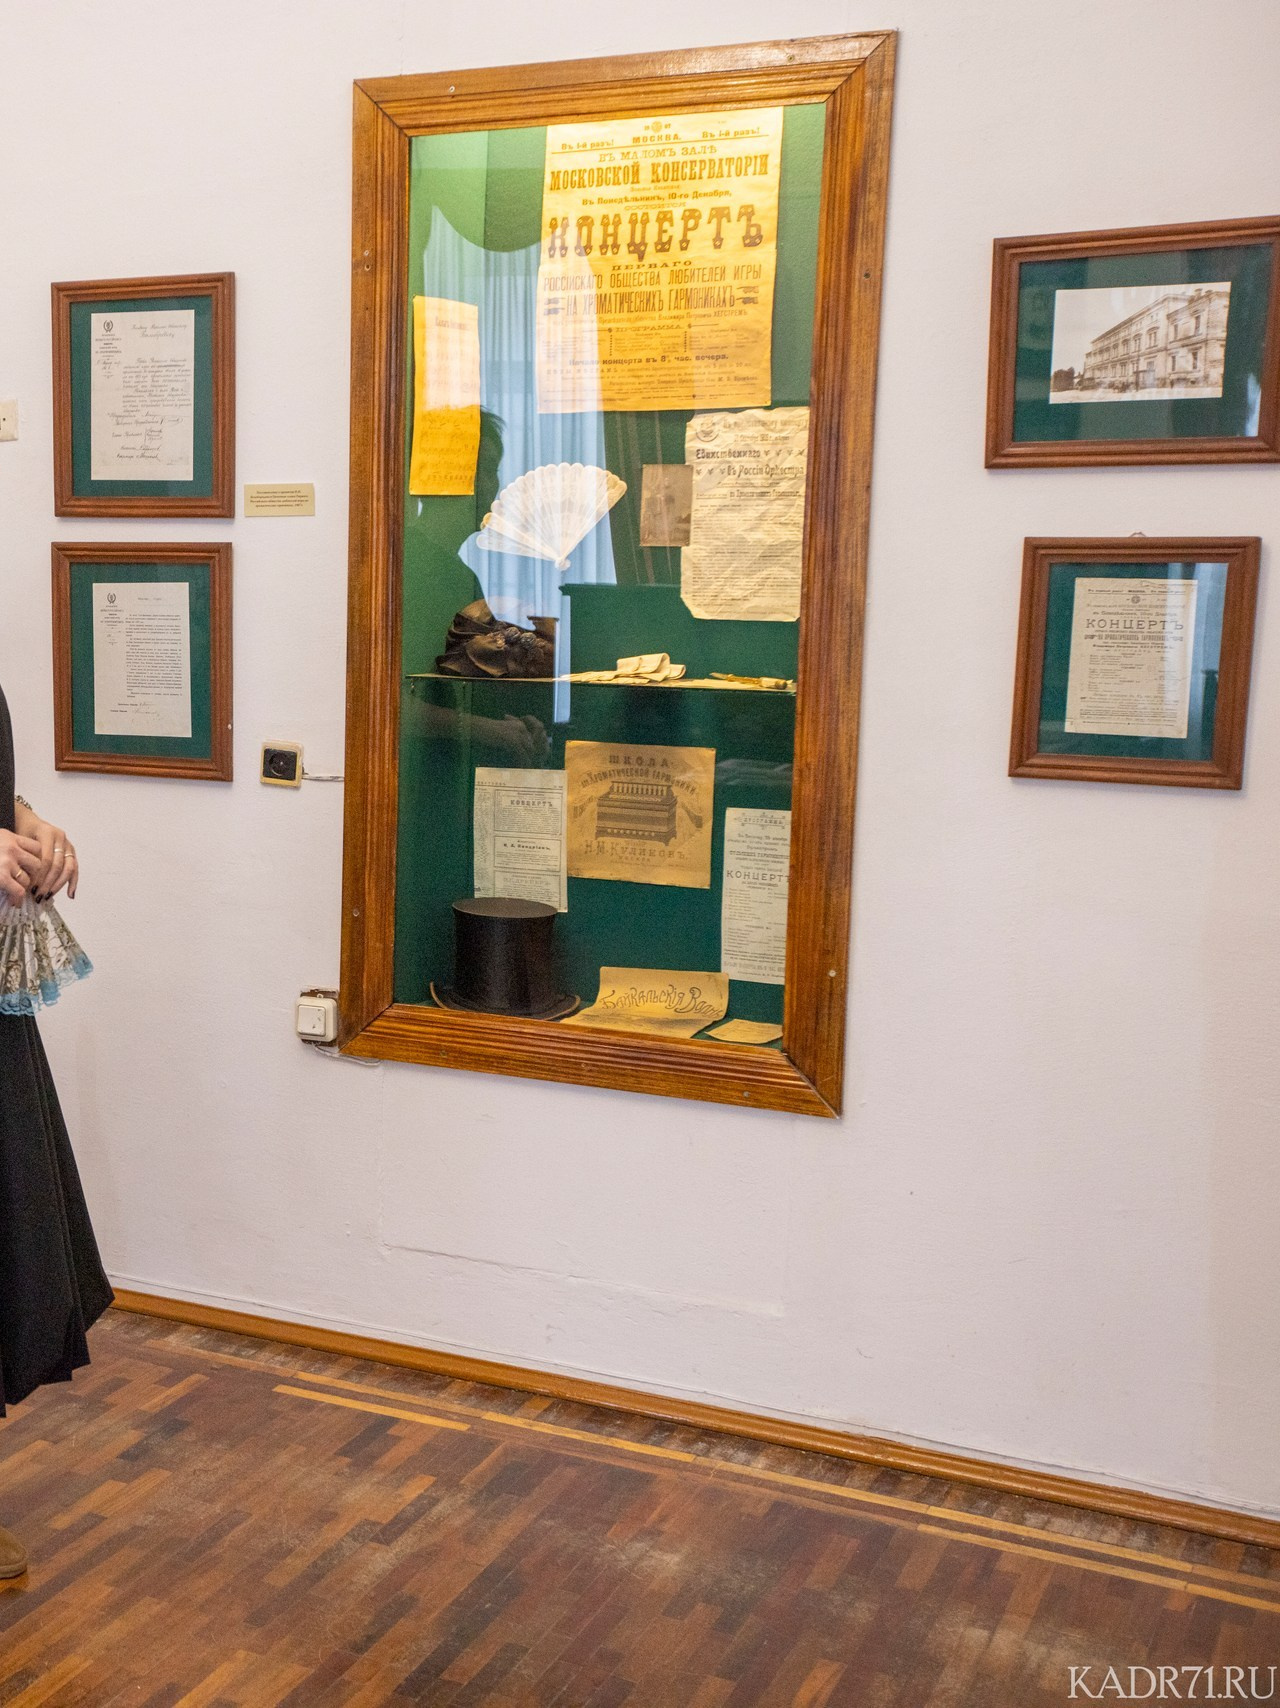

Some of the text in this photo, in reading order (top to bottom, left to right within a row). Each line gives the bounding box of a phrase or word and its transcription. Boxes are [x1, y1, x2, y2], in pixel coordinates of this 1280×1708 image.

[590, 139, 614, 150] разъ!
[632, 133, 681, 144] МОСКВА.
[734, 126, 760, 137] разъ!
[598, 153, 615, 162] ВЪ
[620, 148, 676, 160] МАЛОМЪ
[550, 154, 770, 191] МОСКОВСКОЙ КОНСЕРВАТОРІИ
[692, 189, 732, 200] Декабря,
[548, 204, 764, 262] КОНЦЕРТЪ
[611, 260, 692, 272] ПЕРВАГО
[610, 271, 661, 288] ОБЩЕСТВА
[668, 265, 726, 284] ЛЮБИТЕЛЕЙ
[734, 264, 762, 280] ИГРЫ
[567, 285, 735, 316] НА ХРОМАТИЧЕСКИХЪ ГАРМОНИКАХЪ
[602, 358, 642, 366] концерта
[695, 354, 728, 362] вечера.
[1085, 618, 1184, 630] КОНЦЕРТЪ
